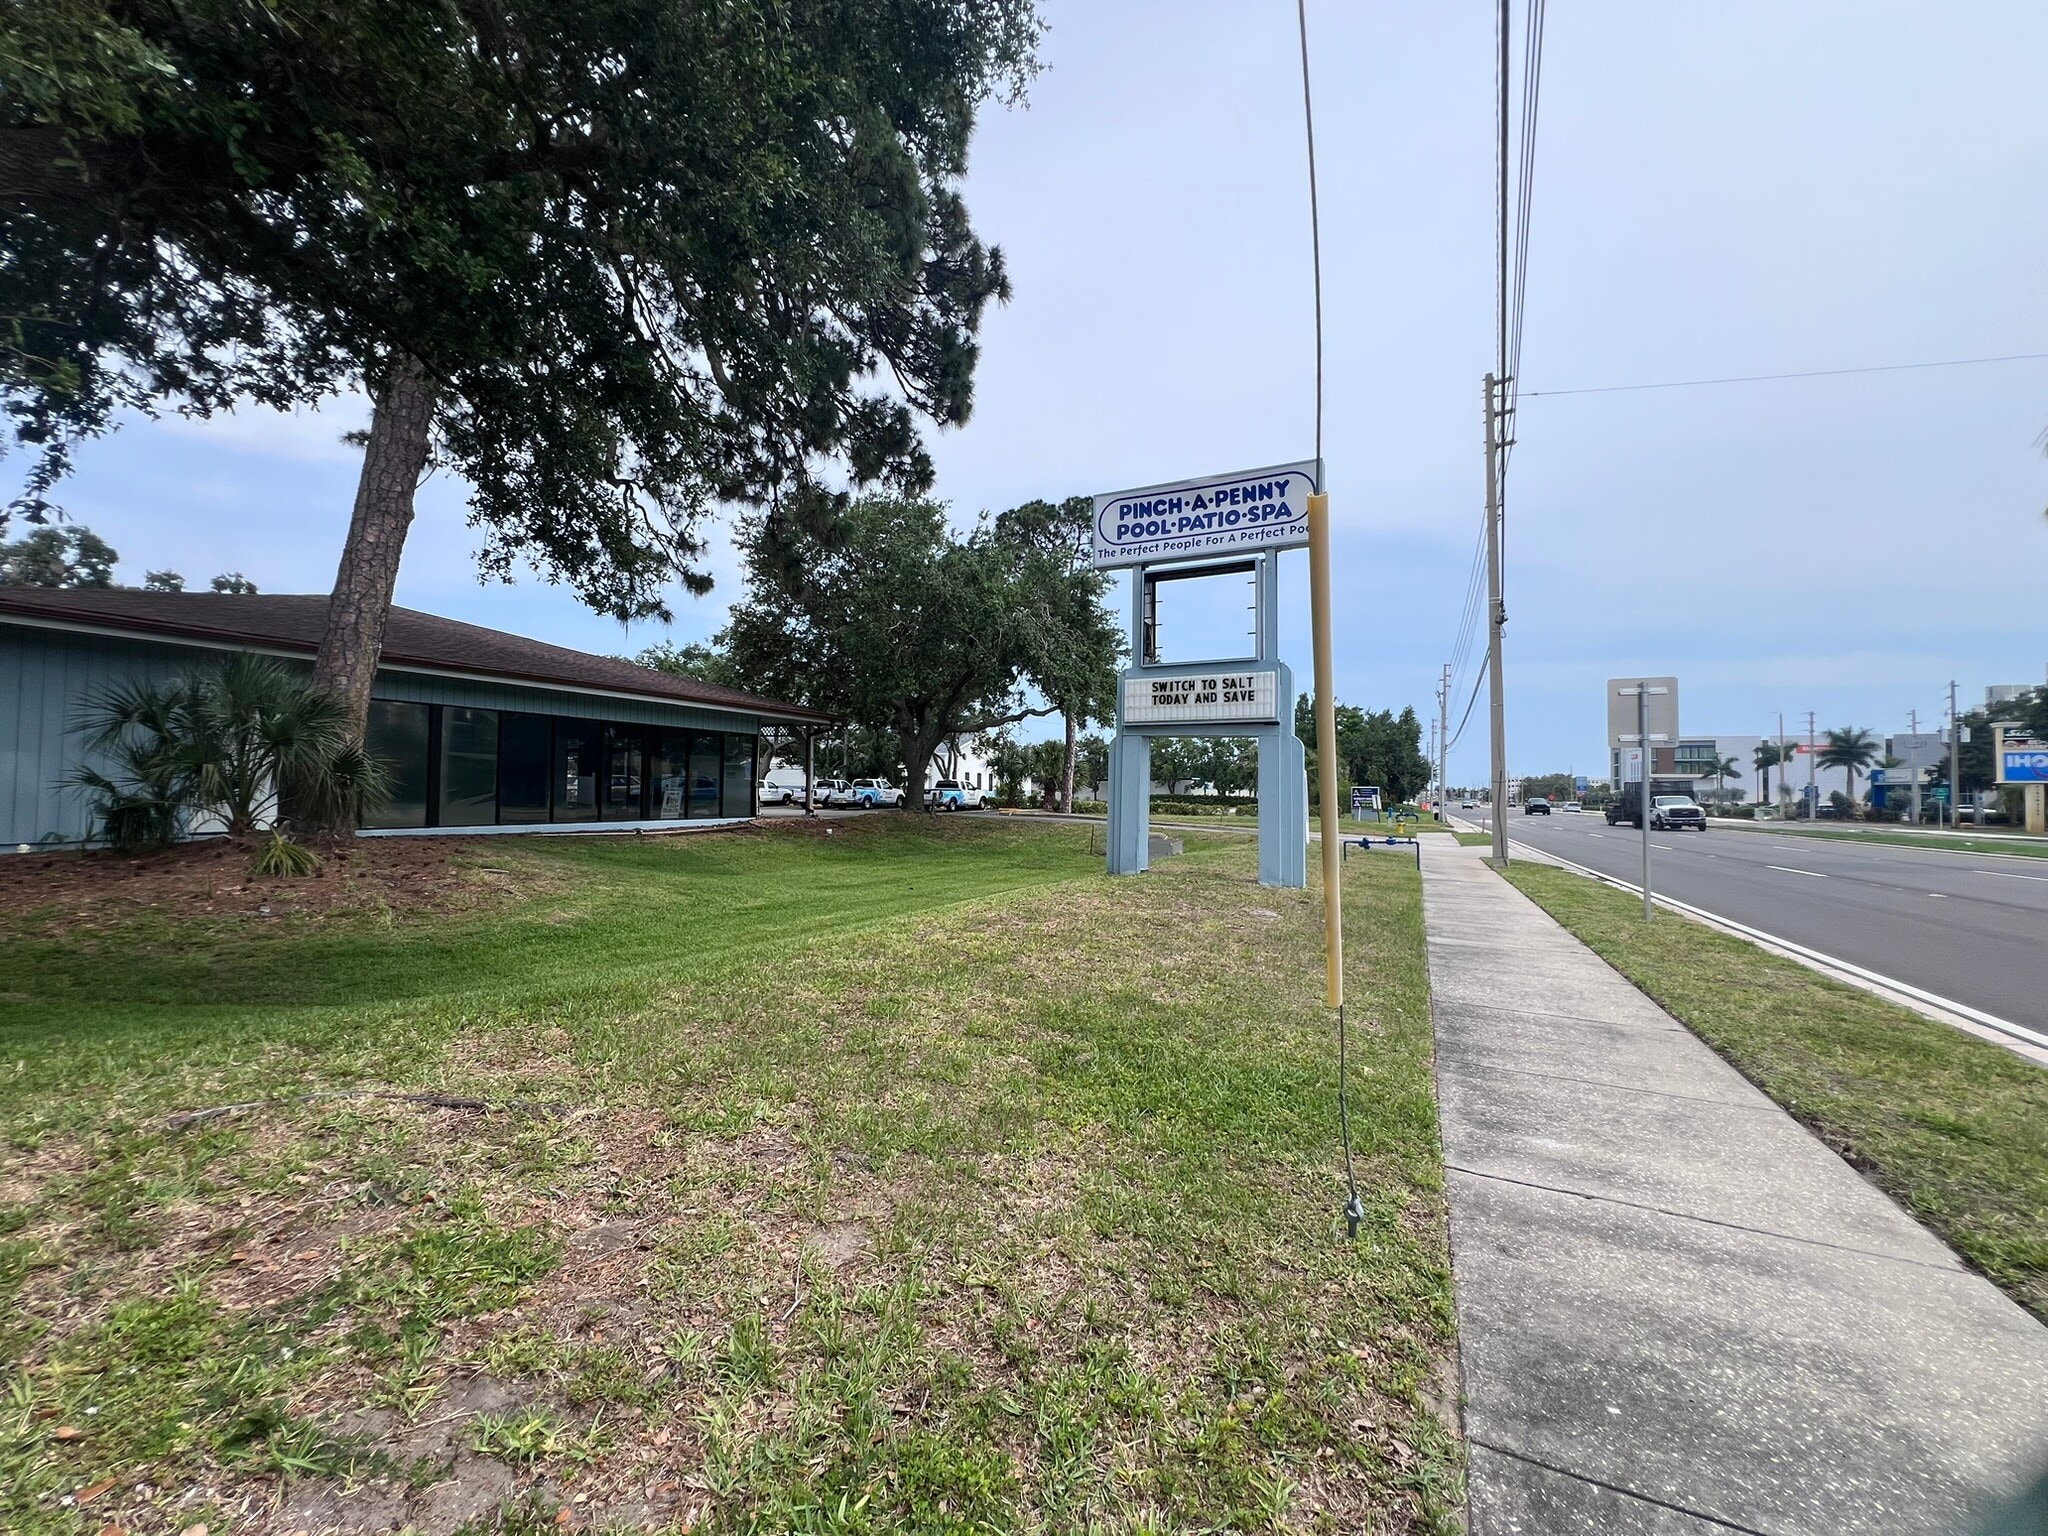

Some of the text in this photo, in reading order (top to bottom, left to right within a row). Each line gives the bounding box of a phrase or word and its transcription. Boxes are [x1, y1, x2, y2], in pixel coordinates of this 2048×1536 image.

[1098, 549, 1117, 559] The
[1120, 543, 1159, 557] Perfect
[1164, 537, 1202, 555] People
[1206, 535, 1225, 545] For
[1228, 533, 1236, 542] A
[1241, 526, 1285, 542] Perfect
[1152, 677, 1254, 692] SWITCH TO SALT
[1152, 690, 1255, 705] TODAY AND SAVE
